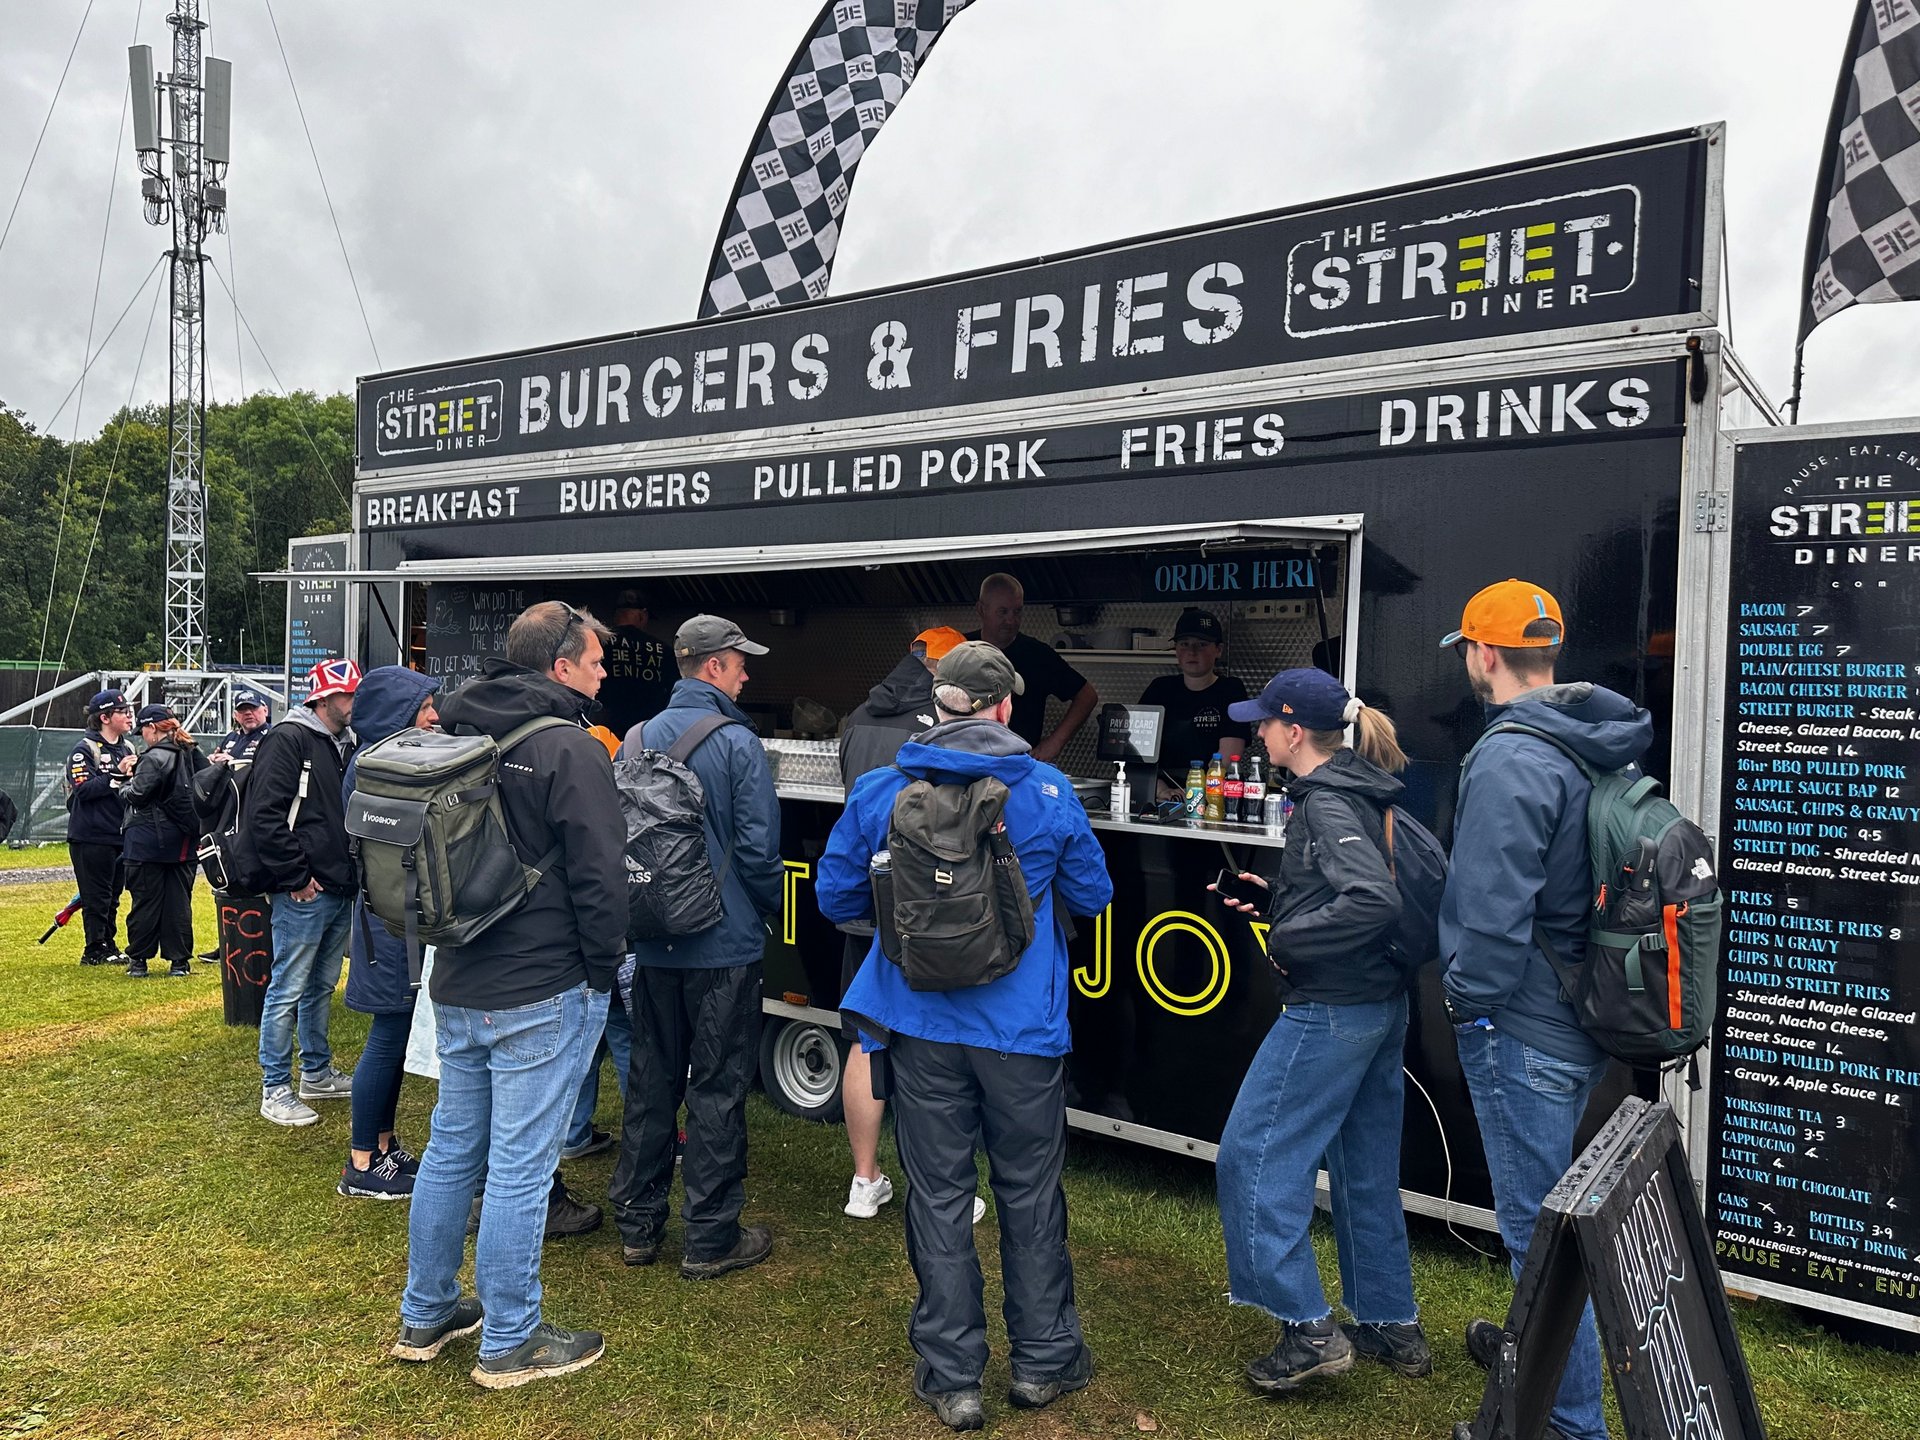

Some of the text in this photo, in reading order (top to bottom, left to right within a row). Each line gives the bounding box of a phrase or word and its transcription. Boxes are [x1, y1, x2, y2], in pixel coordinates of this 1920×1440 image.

[1320, 221, 1386, 251] THE
[1309, 214, 1610, 311] STREET
[1450, 285, 1588, 321] DINER
[520, 261, 1245, 435] BURGERS & FRIES
[389, 389, 414, 404] THE
[385, 395, 493, 440] STREET
[367, 378, 1651, 526] BREAKFAST BURGERS PULLED PORK FRIES DRINKS
[437, 434, 485, 451] DINER
[1784, 445, 1880, 494] PAUSE EAT
[1835, 475, 1891, 489] THE
[1795, 546, 1920, 564] DINER
[1154, 562, 1241, 592] ORDER
[508, 589, 525, 609] THE
[1741, 604, 1814, 616] BACON 7
[1740, 623, 1829, 636] SAUSAGE 7
[472, 634, 487, 650] THE
[1739, 644, 1851, 657] DOUBLE EGG 7
[428, 655, 482, 675] TO GET SOME
[636, 654, 663, 668] EAT
[1741, 663, 1906, 678] PLAIN/CHEESE BURGER
[1740, 683, 1784, 695] BACON
[1789, 684, 1843, 697] CHEESE
[1847, 685, 1907, 699] BURGER
[1739, 702, 1914, 720] STREET BURGER Steak
[1110, 719, 1154, 729] PAY BY CARD
[1738, 722, 1905, 740] Cheese, Glazed Bacon,
[1737, 740, 1858, 756] Street Sauce 14
[1737, 758, 1906, 779] 16hr BBQ PULLED PORK
[1736, 778, 1899, 798] & APPLE SAUCE BAP 12
[1735, 798, 1920, 822] SAUSAGE, CHIPS & GRAVY
[1734, 819, 1782, 834] JUMBO
[1788, 823, 1813, 836] HOT
[1819, 824, 1847, 839] DOG
[1734, 839, 1786, 855] STREET
[1791, 843, 1819, 857] DOG
[1833, 848, 1909, 865] Shredded
[1733, 858, 1780, 873] Glazed
[1785, 861, 1834, 879] Bacon,
[1839, 865, 1887, 882] Street
[1731, 890, 1798, 909] FRIES 5
[221, 905, 264, 938] FC
[1730, 910, 1901, 940] NACHO CHEESE FRIES 8
[1729, 930, 1839, 954] CHIPS N GRAVY
[225, 949, 268, 986] KC
[1728, 950, 1838, 974] CHIPS N CURRY
[1728, 968, 1890, 1001] LOADED STREET FRIES
[1736, 989, 1916, 1025] Shredded Maple Glazed
[1727, 1007, 1889, 1042] Bacon, Nacho Cheese,
[1726, 1026, 1843, 1056] Street Sauce 14
[1726, 1045, 1777, 1064] LOADED
[1782, 1052, 1834, 1072] PULLED
[1840, 1061, 1880, 1080] PORK
[1734, 1067, 1901, 1107] Gravy, Apple Sauce 12
[1724, 1096, 1846, 1129] YORKSHIRE TEA 3
[1723, 1114, 1795, 1136] AMERICANO
[1722, 1130, 1795, 1154] CAPPUCCINO
[1722, 1147, 1759, 1165] LATTE
[1721, 1164, 1898, 1210] LUXURY HOT CHOCOLATE 4
[1718, 1192, 1749, 1208] CANS
[1718, 1208, 1764, 1230] WATER
[1809, 1210, 1865, 1233] BOTTLES
[1717, 1230, 1747, 1244] FOOD
[1748, 1236, 1807, 1256] ALLERGIES?
[1809, 1251, 1837, 1265] Please
[1838, 1257, 1853, 1268] ask
[1862, 1264, 1900, 1278] member
[1901, 1272, 1912, 1281] of
[1809, 1228, 1908, 1260] ENERGY DRINK
[1715, 1240, 1780, 1269] PAUSE
[1807, 1260, 1848, 1283] EAT
